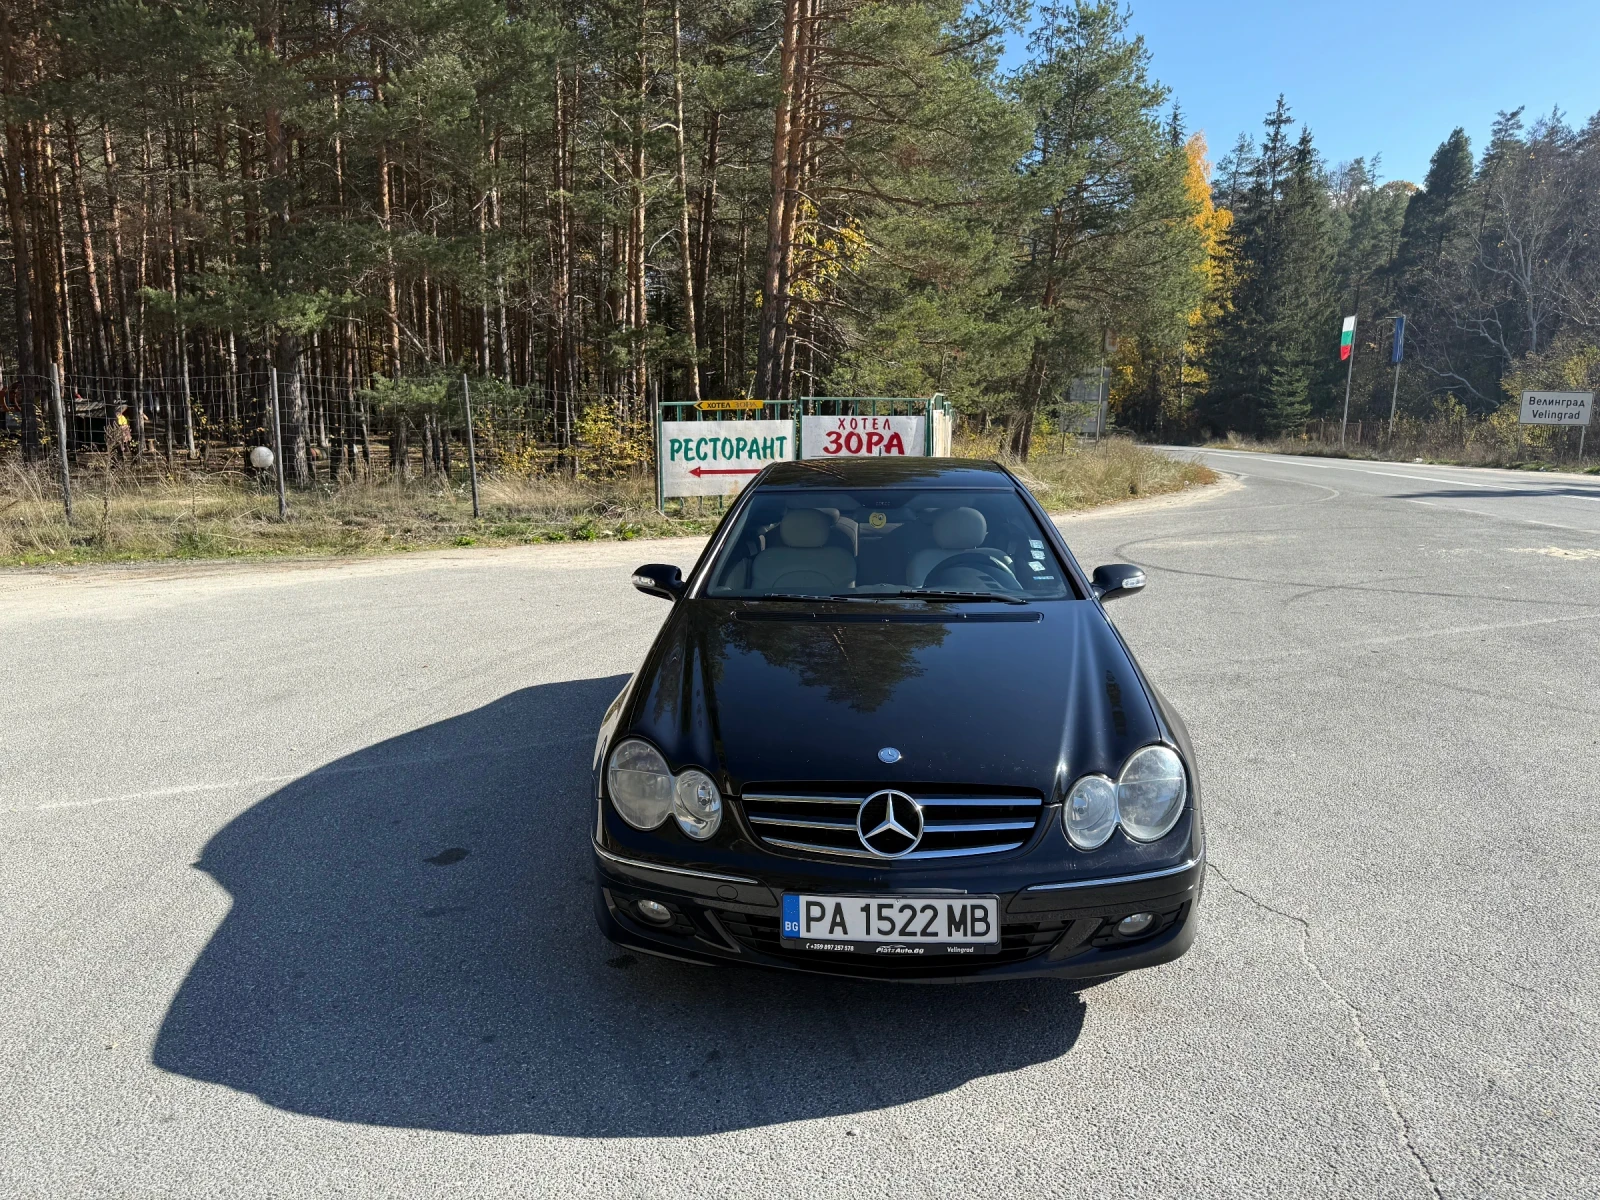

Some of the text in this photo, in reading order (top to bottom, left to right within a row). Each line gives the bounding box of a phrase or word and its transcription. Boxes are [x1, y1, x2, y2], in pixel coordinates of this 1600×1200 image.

[1528, 396, 1585, 408] Велинград
[1532, 410, 1580, 421] Velingrad
[838, 417, 891, 430] ХОТЕЛ
[669, 435, 788, 462] РЕСТОРАНТ
[823, 430, 905, 455] ЗОРА
[805, 900, 990, 937] PA 1522 MB
[785, 921, 799, 932] BG
[947, 946, 974, 954] Velingrad
